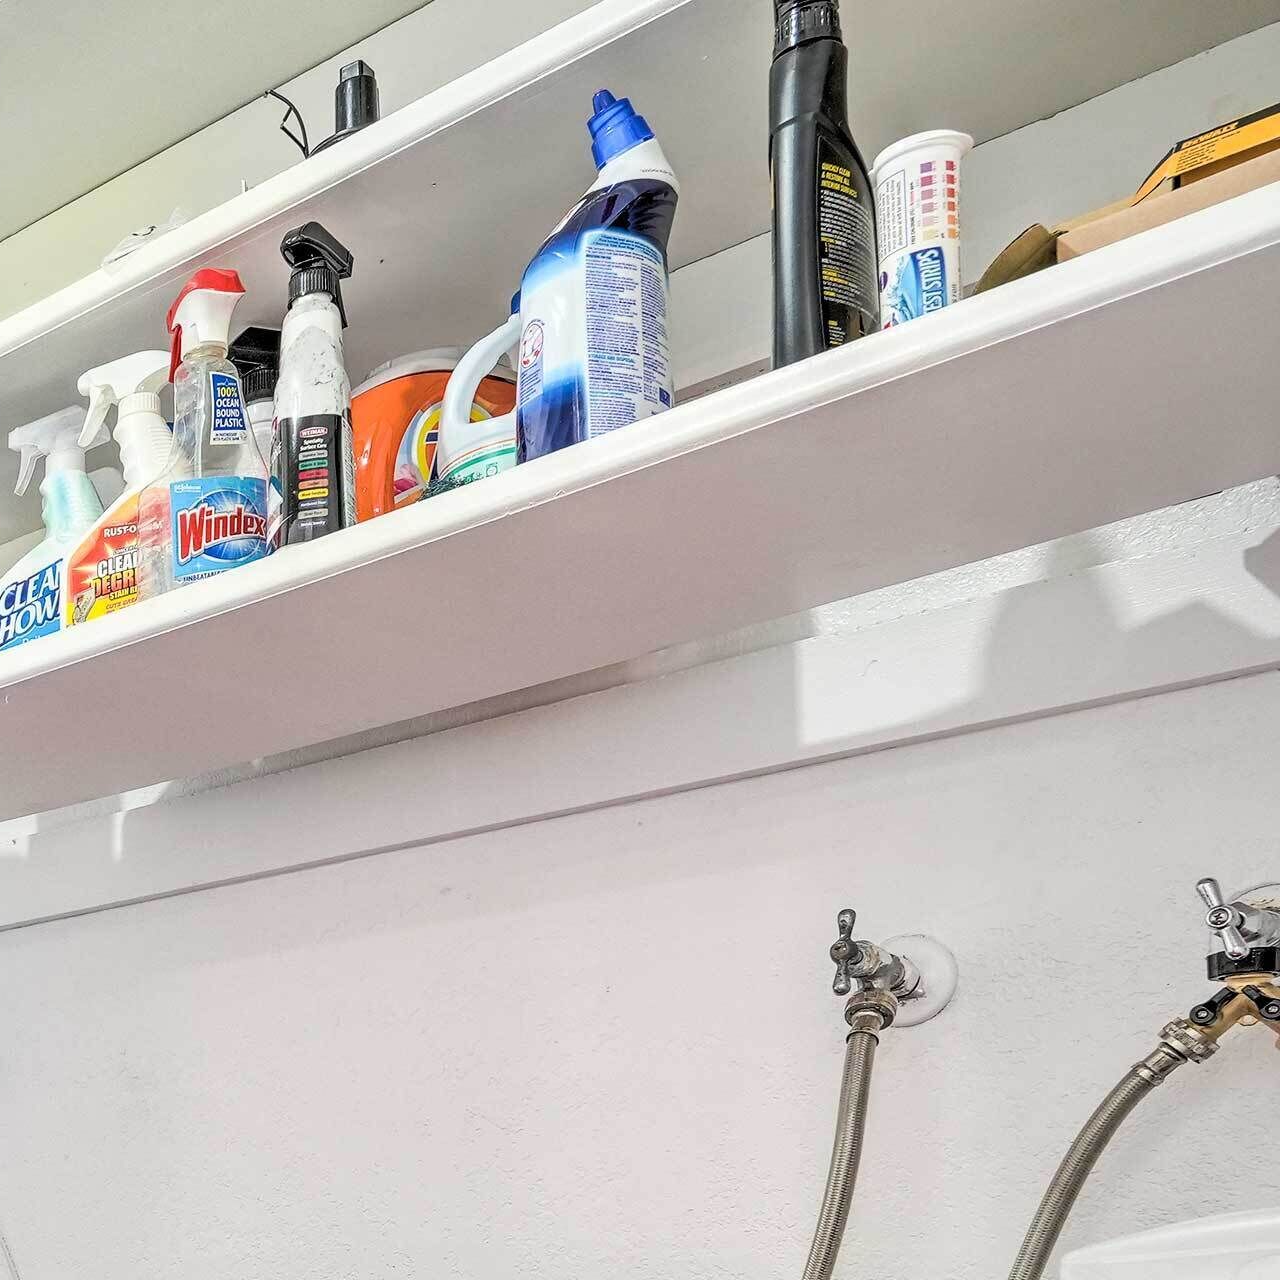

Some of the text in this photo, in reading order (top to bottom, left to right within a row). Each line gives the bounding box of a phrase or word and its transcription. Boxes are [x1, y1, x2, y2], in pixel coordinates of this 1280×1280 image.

[916, 248, 942, 290] STRIPS
[217, 387, 238, 397] 100%
[216, 398, 239, 408] OCEAN
[216, 409, 240, 417] BOUND
[215, 418, 243, 428] PLASTIC
[178, 503, 267, 562] Windex
